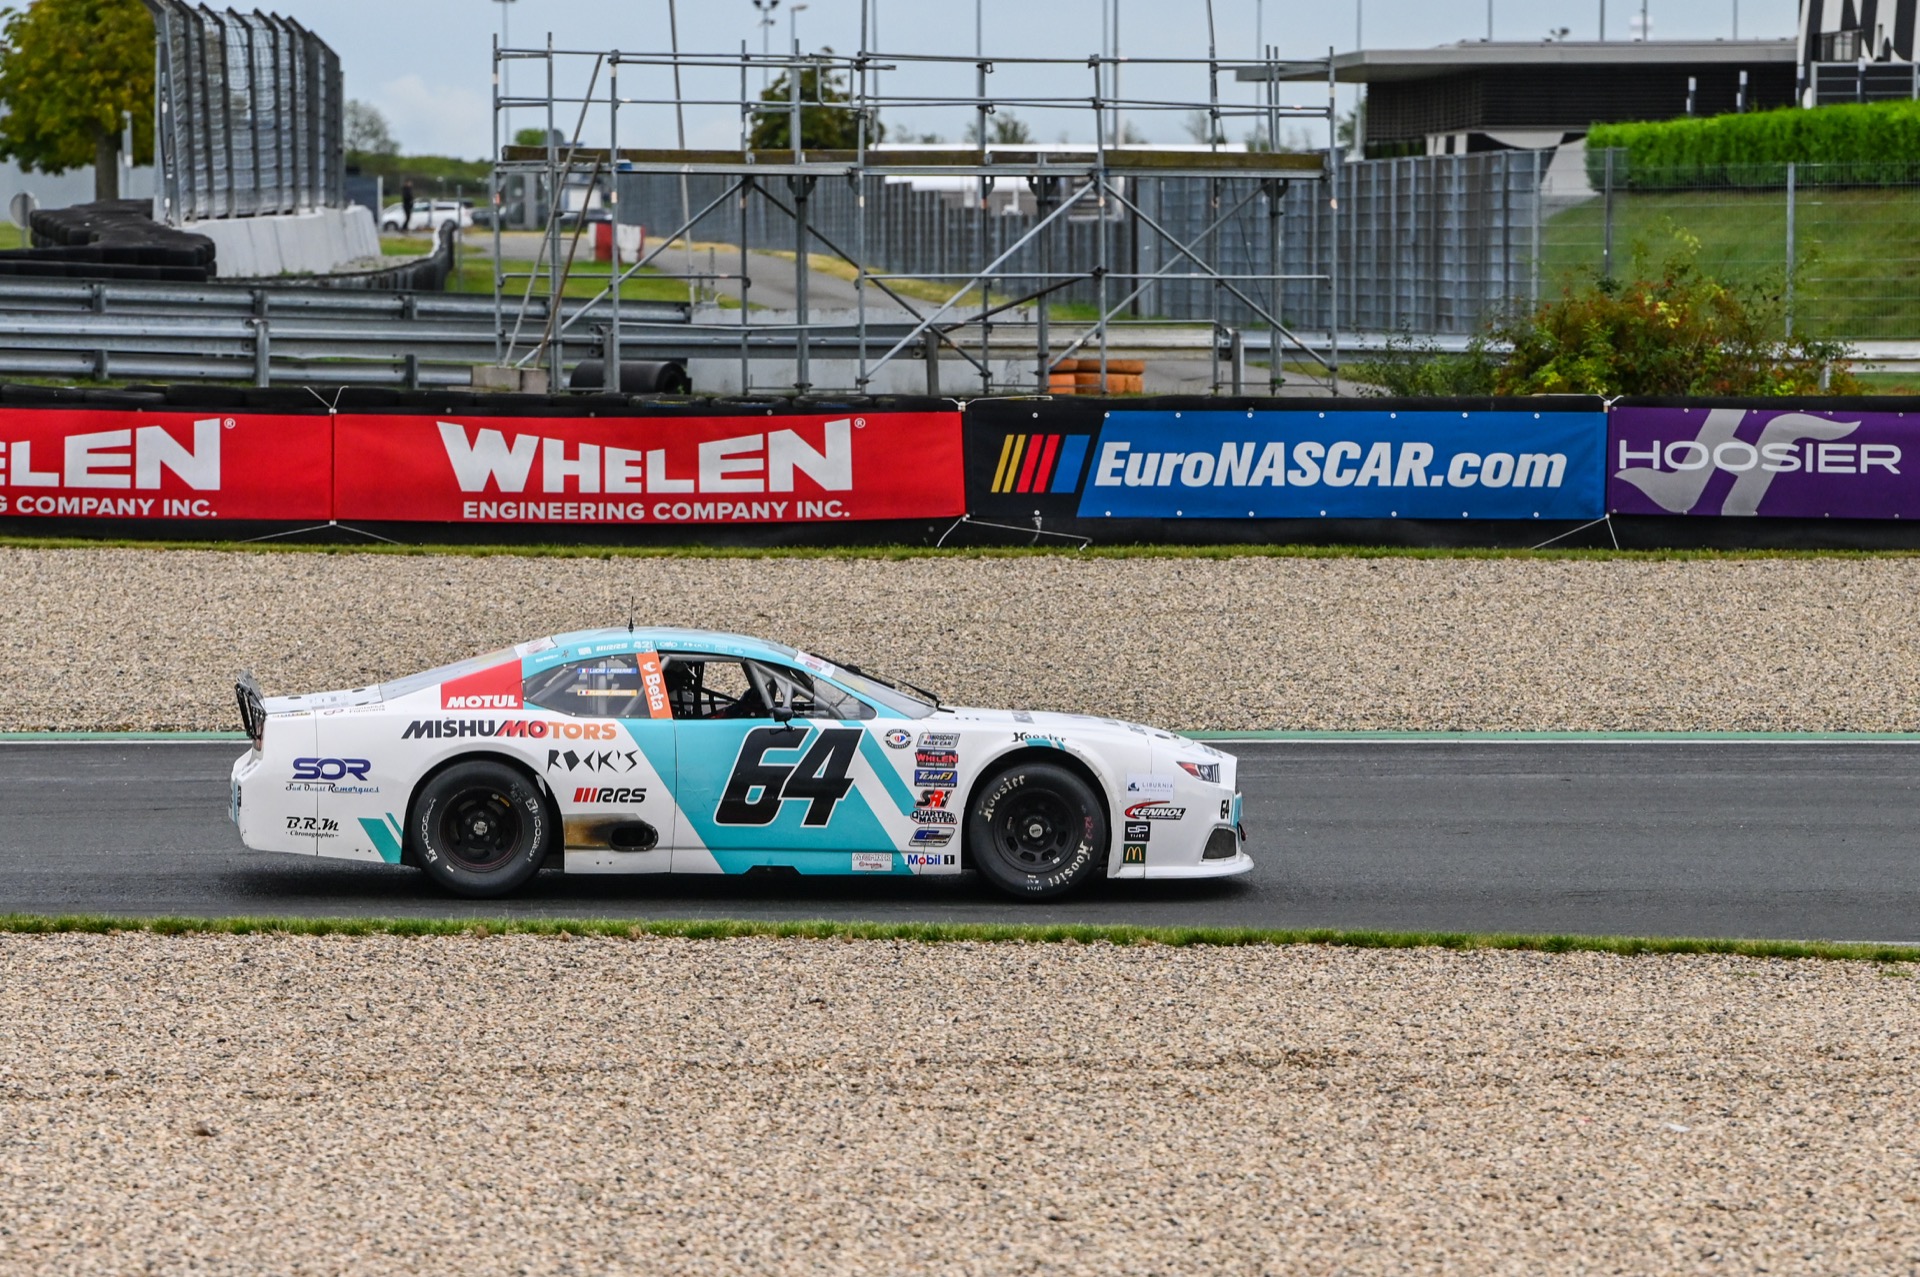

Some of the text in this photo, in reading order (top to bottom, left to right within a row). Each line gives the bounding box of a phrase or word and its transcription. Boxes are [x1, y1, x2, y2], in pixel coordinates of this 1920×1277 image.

[0, 417, 221, 491] LEN
[436, 418, 853, 494] WHELEN
[1094, 441, 1567, 488] EuroNASCAR.com
[1618, 439, 1901, 475] HOOSIER
[16, 496, 154, 515] COMPANY
[163, 499, 218, 516] INC.
[463, 500, 851, 520] ENGINEERING COMPANY INC.
[446, 694, 518, 709] MOTUL
[645, 673, 664, 711] Beta
[292, 757, 371, 781] SOR
[713, 726, 866, 828] 64
[597, 788, 647, 803] RRS
[1130, 808, 1183, 816] KENNOL
[1220, 800, 1230, 819] 64
[908, 855, 940, 865] Mobil
